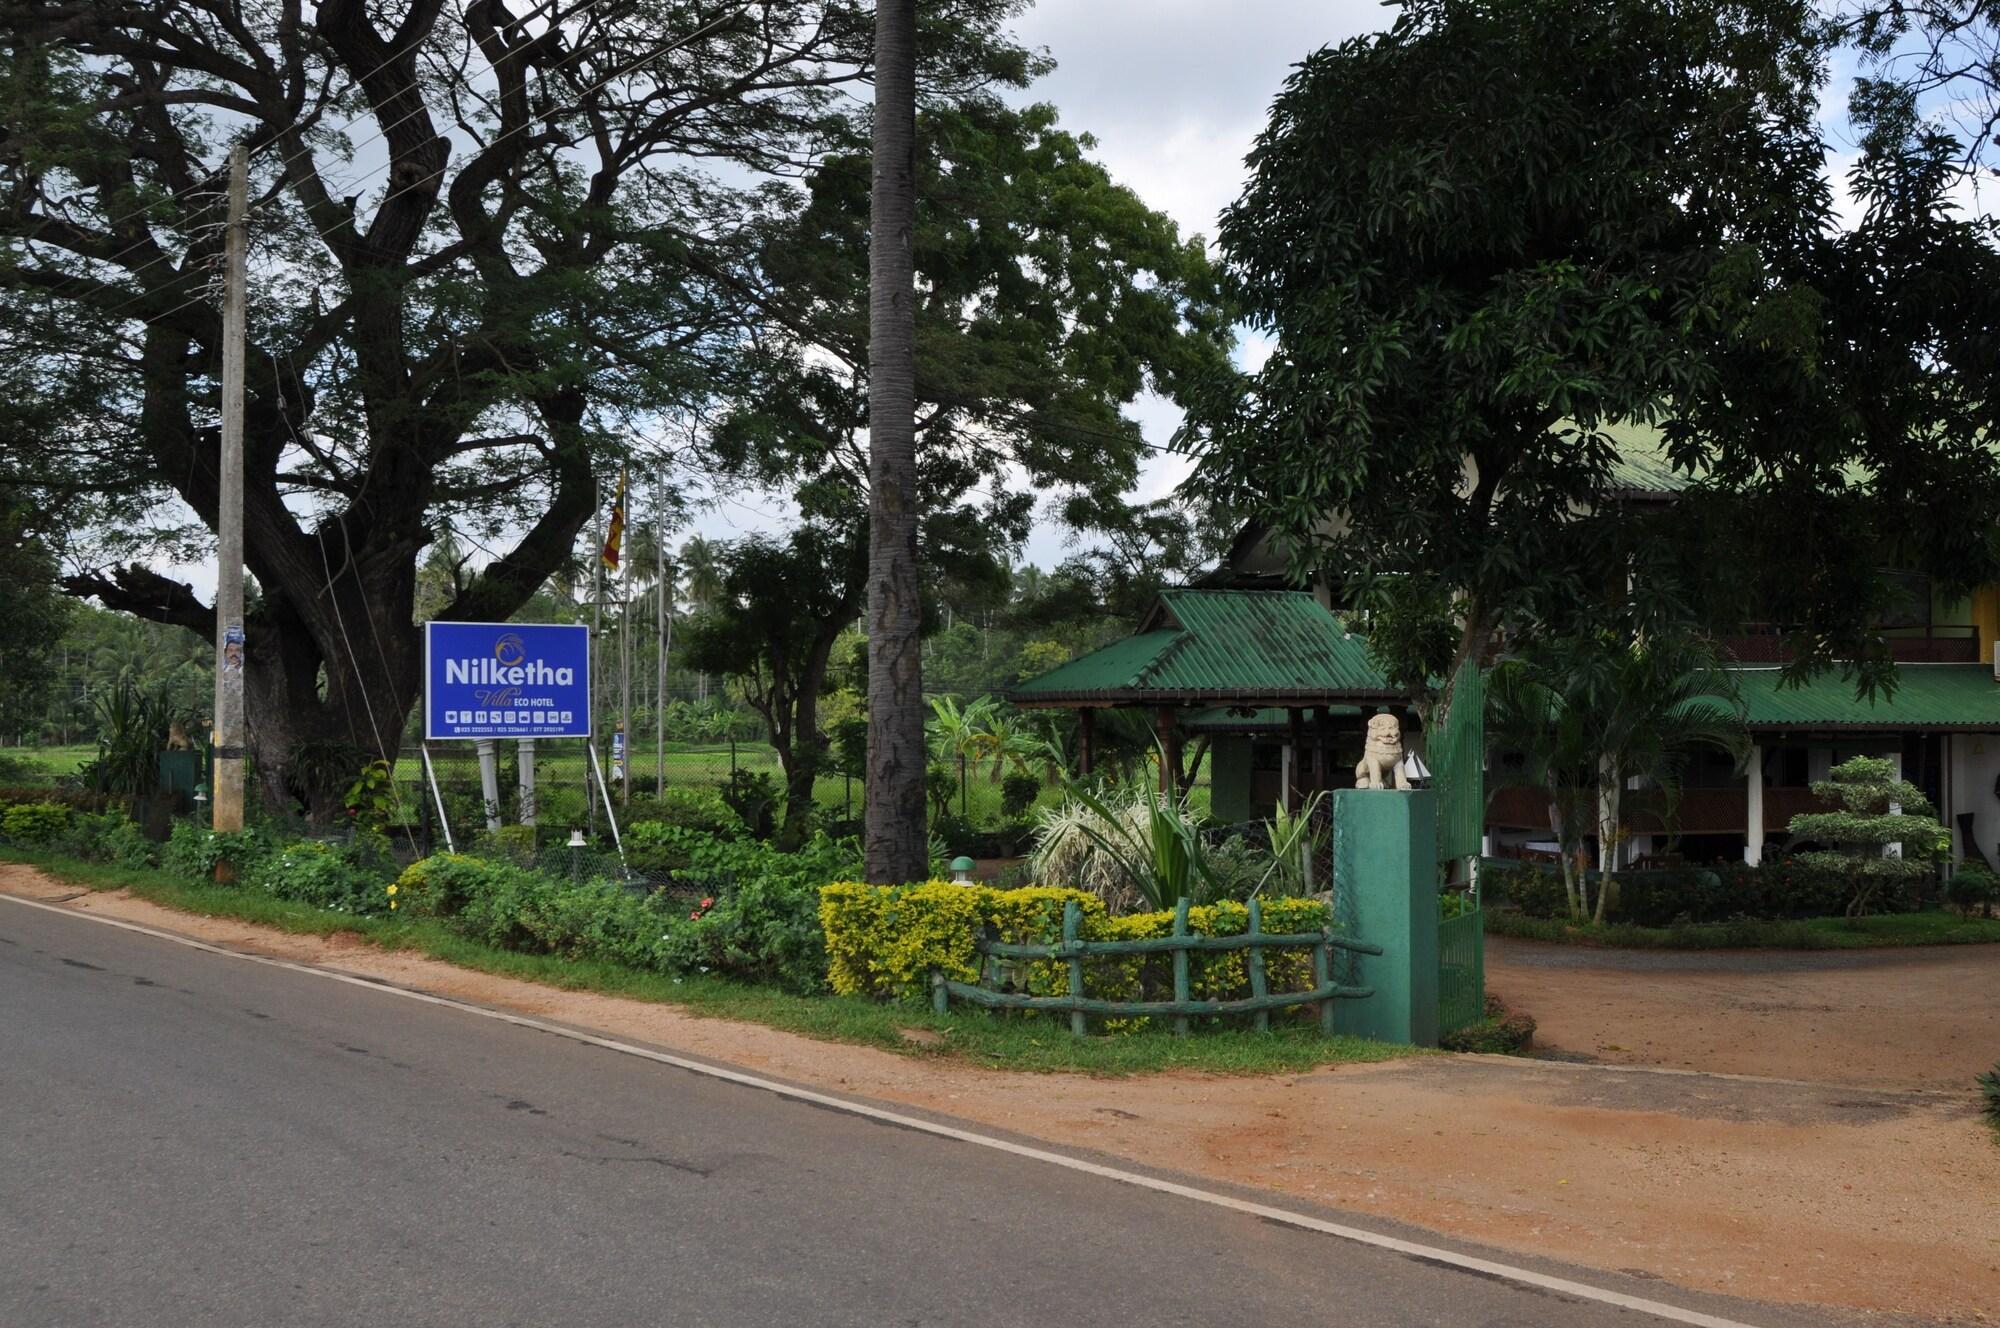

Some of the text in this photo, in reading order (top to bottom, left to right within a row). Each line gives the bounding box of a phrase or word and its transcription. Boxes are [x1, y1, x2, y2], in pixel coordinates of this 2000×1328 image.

[446, 658, 573, 685] Nilketha
[474, 687, 554, 707] Villa ECO HOTEL
